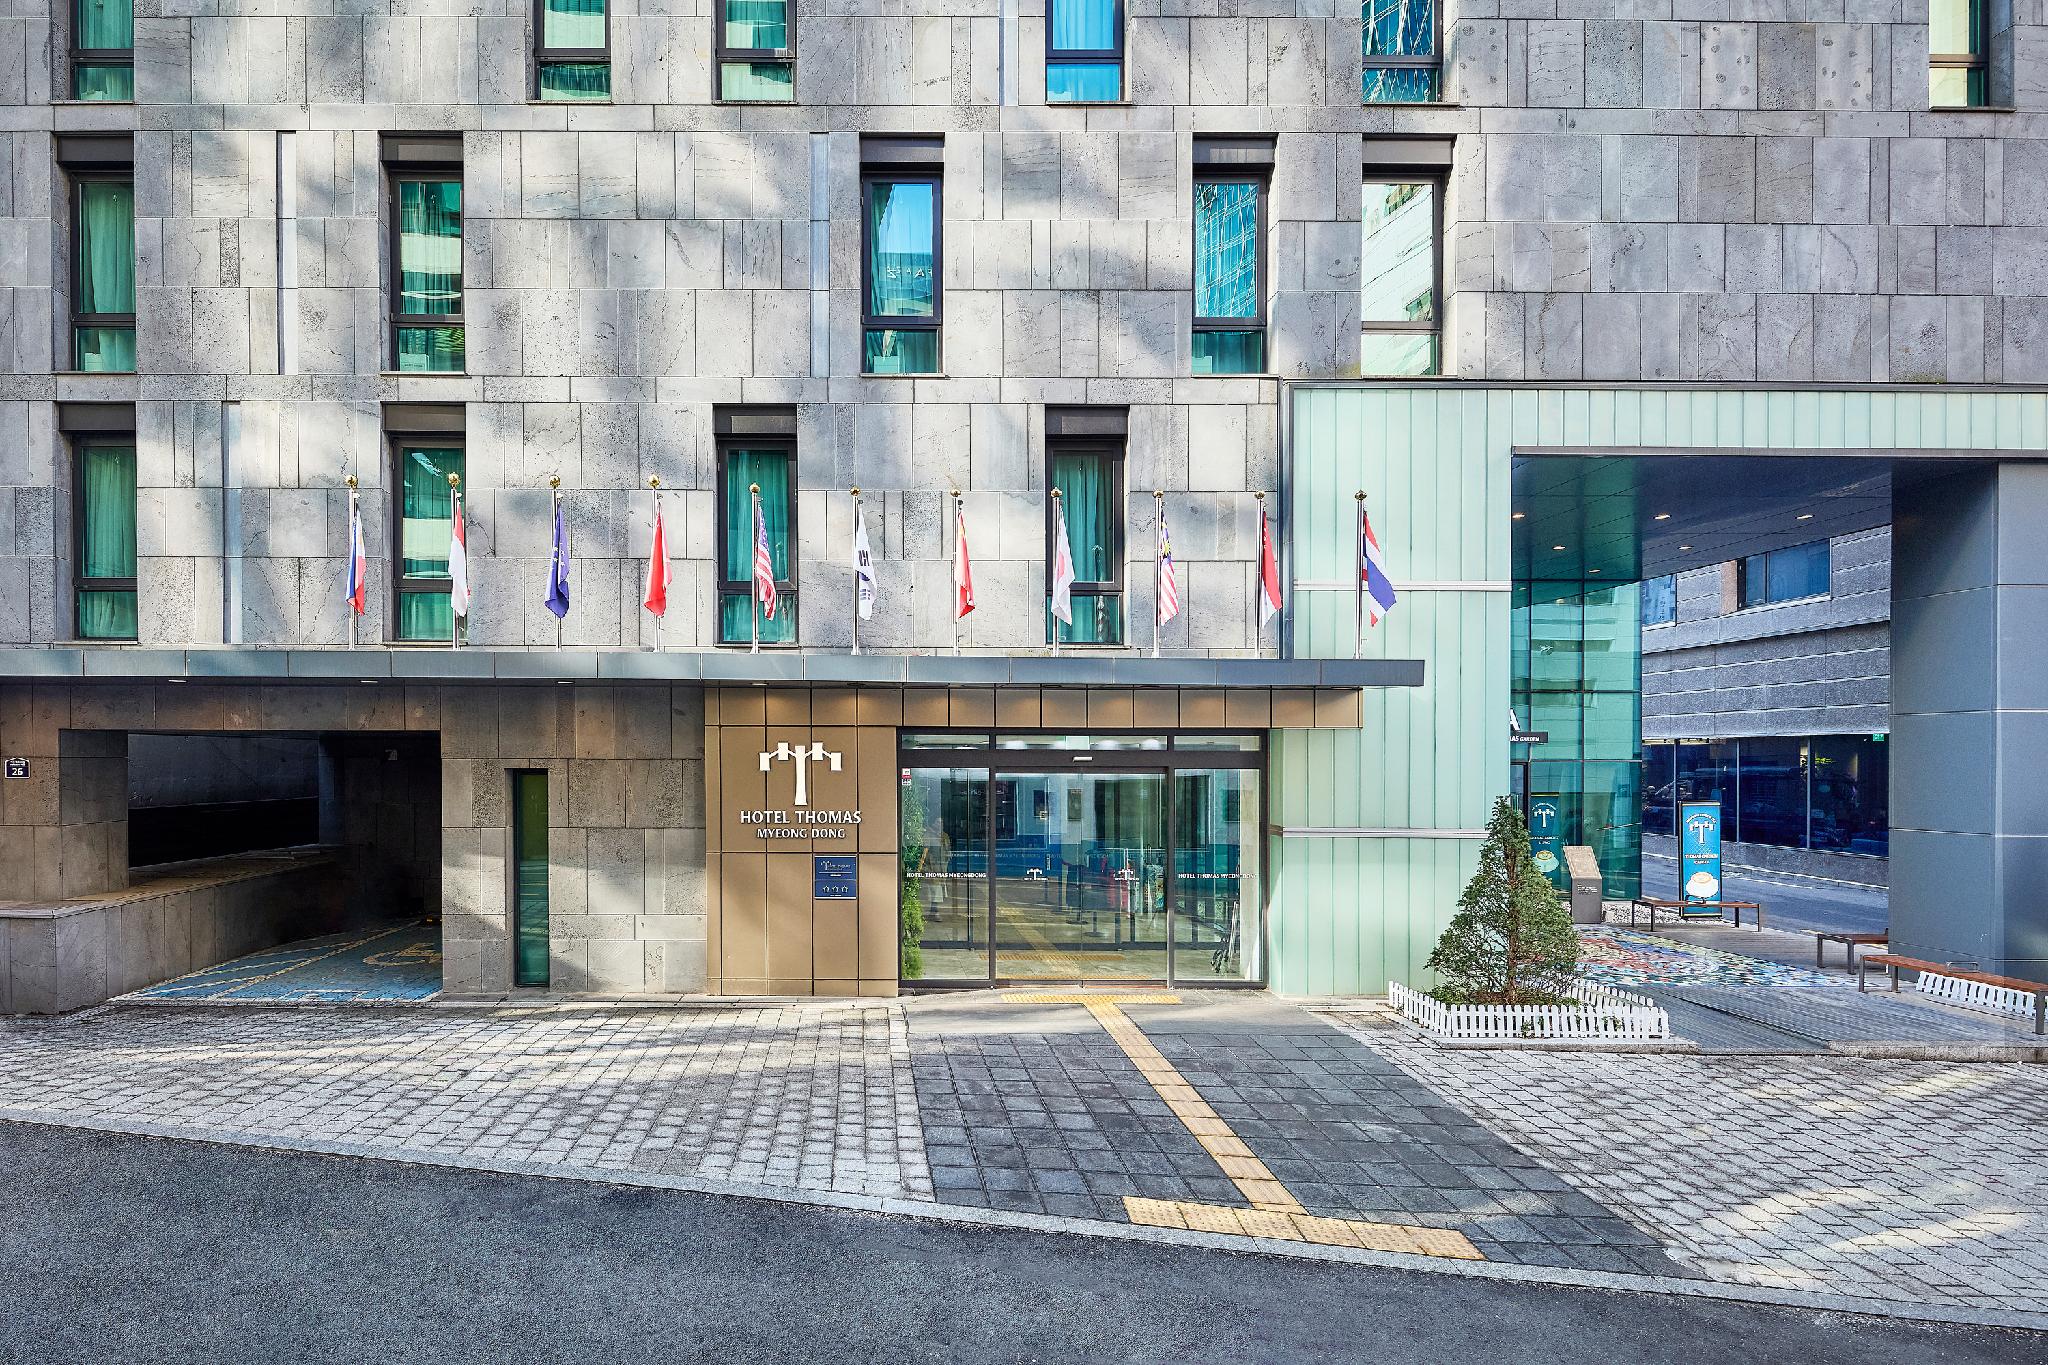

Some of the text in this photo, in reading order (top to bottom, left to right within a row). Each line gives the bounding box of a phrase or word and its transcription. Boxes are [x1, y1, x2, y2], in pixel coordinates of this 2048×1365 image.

[740, 810, 862, 824] HOTEL THOMAS
[757, 828, 846, 838] MYEONG DONG
